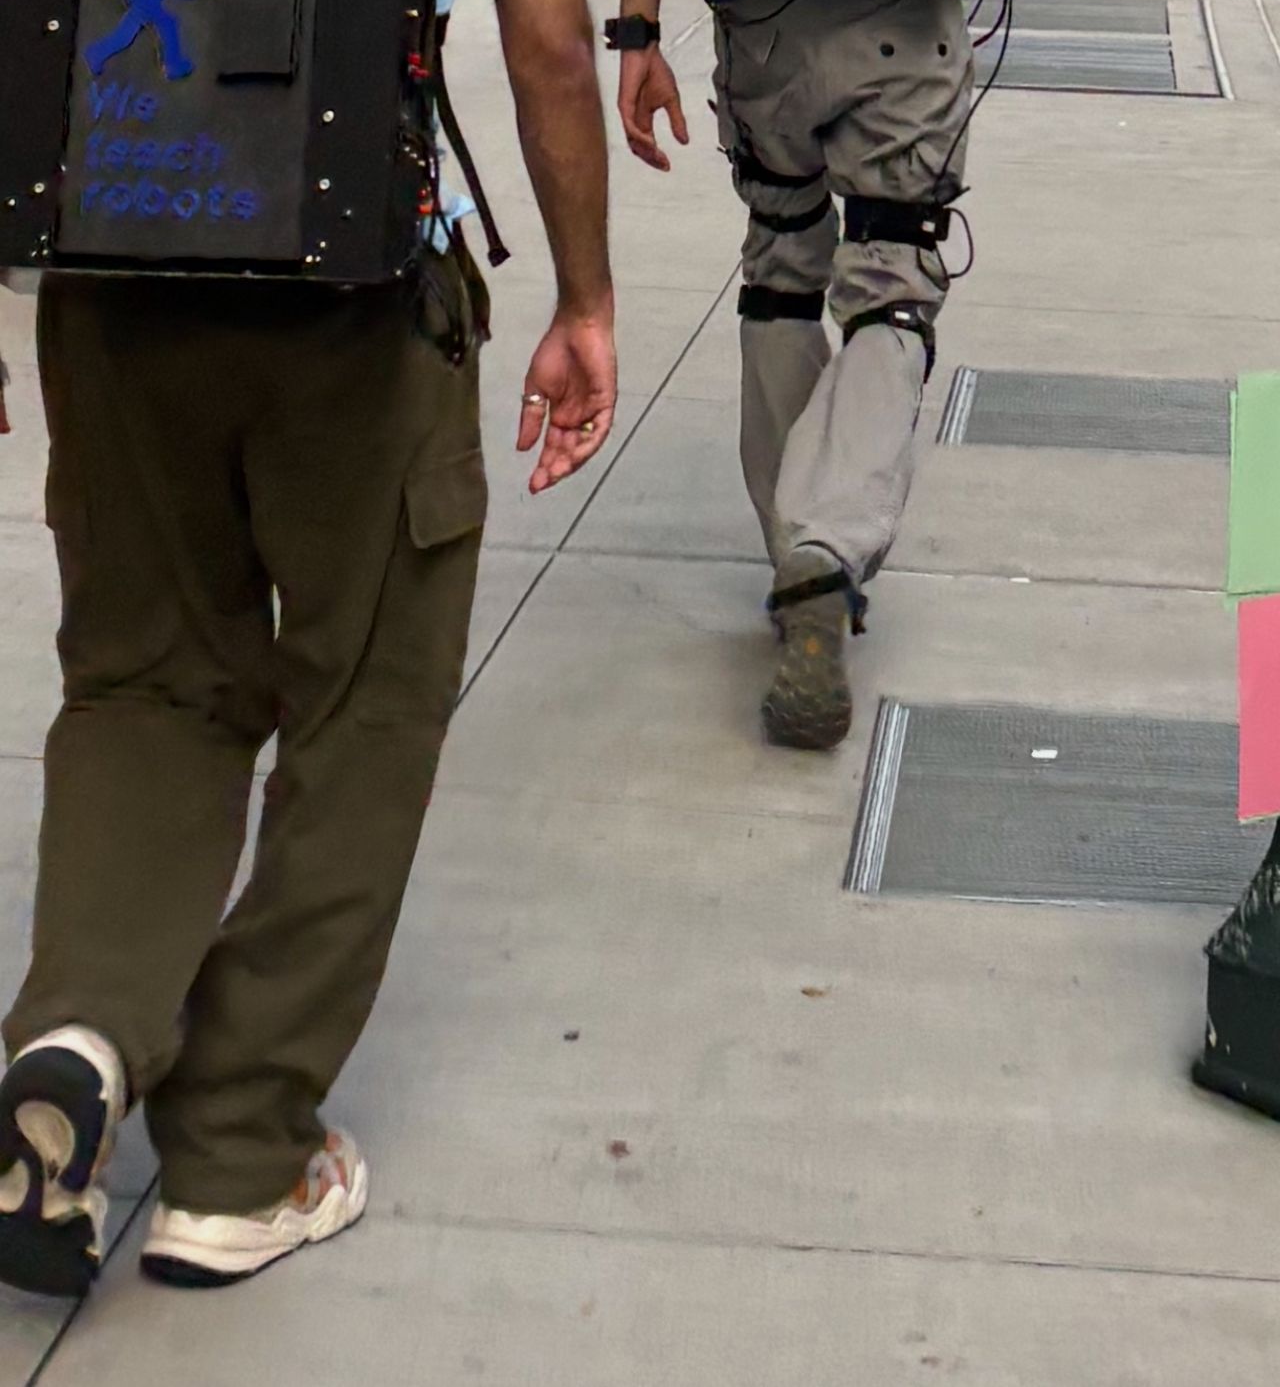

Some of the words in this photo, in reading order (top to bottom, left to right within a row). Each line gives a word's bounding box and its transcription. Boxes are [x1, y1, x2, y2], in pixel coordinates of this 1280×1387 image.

[88, 80, 158, 122] We
[85, 131, 223, 176] teach
[83, 178, 259, 220] robots
